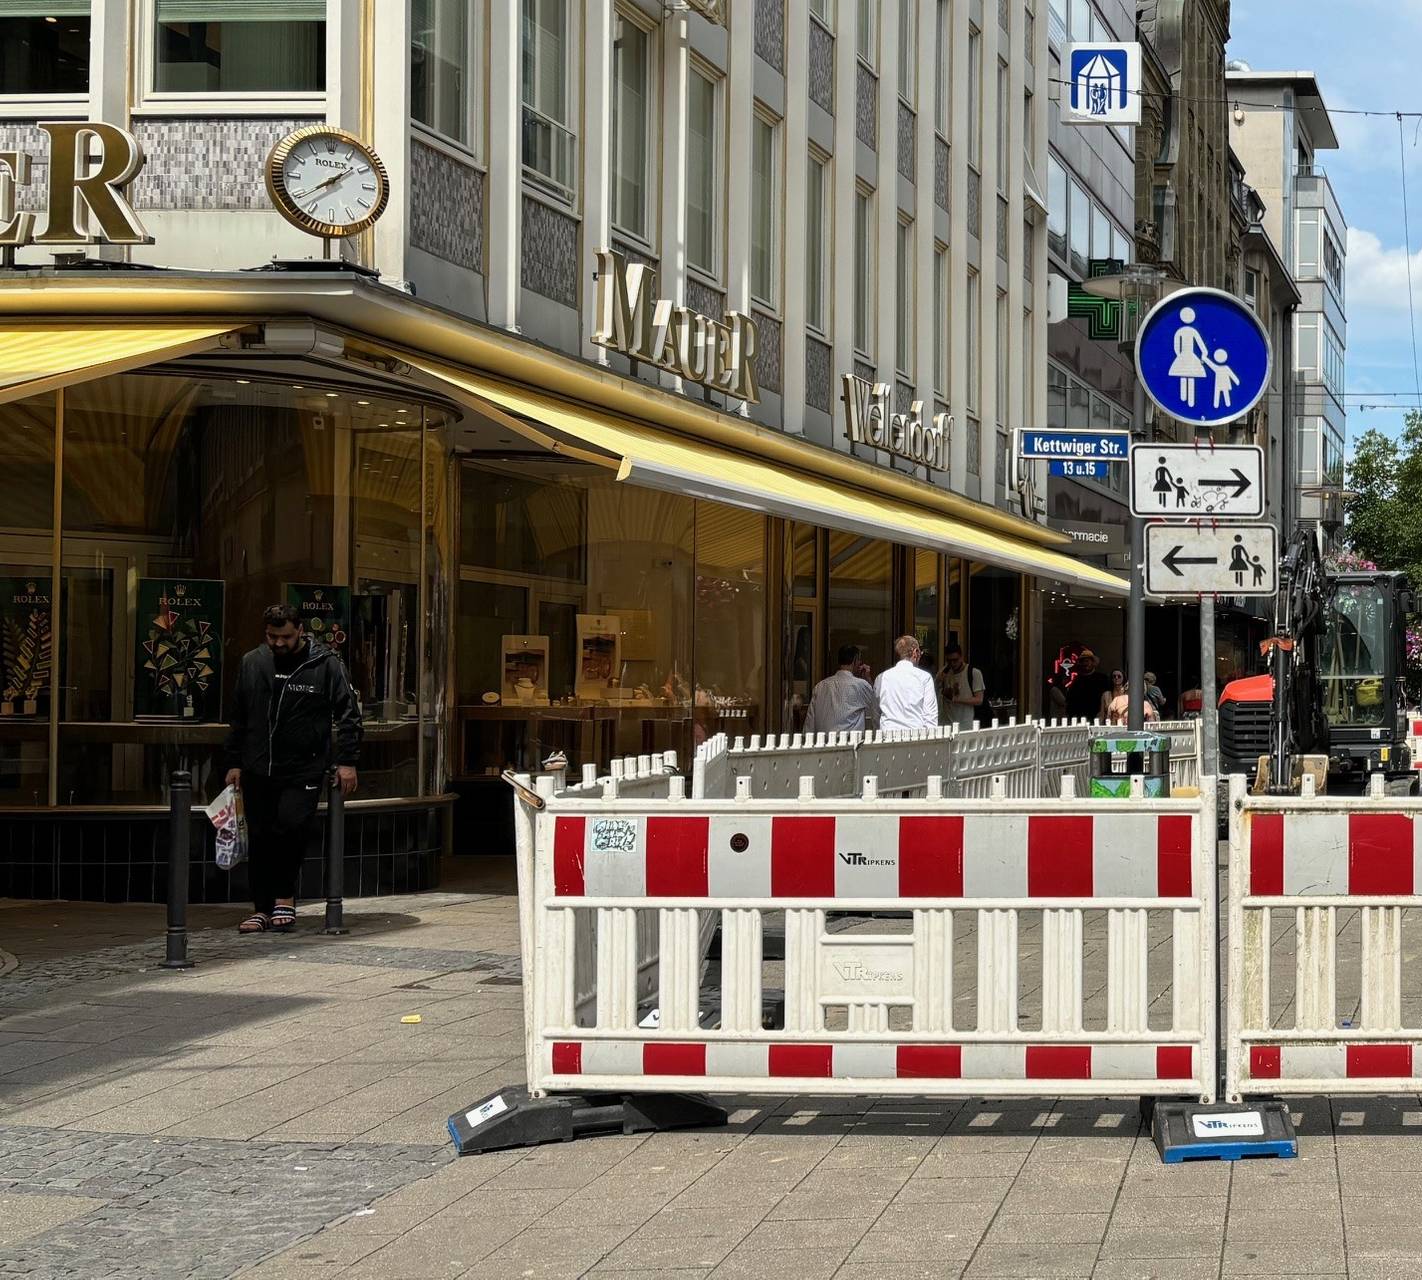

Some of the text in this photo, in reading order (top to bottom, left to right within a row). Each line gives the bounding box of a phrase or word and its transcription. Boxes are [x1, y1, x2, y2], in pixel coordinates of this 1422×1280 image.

[316, 158, 347, 170] ROLEX
[1034, 437, 1123, 456] Kettwiger Str.
[1063, 461, 1096, 475] 13 u.15
[13, 595, 50, 604] ROLEX
[159, 597, 201, 606] ROLEX
[302, 602, 334, 611] ROLEX
